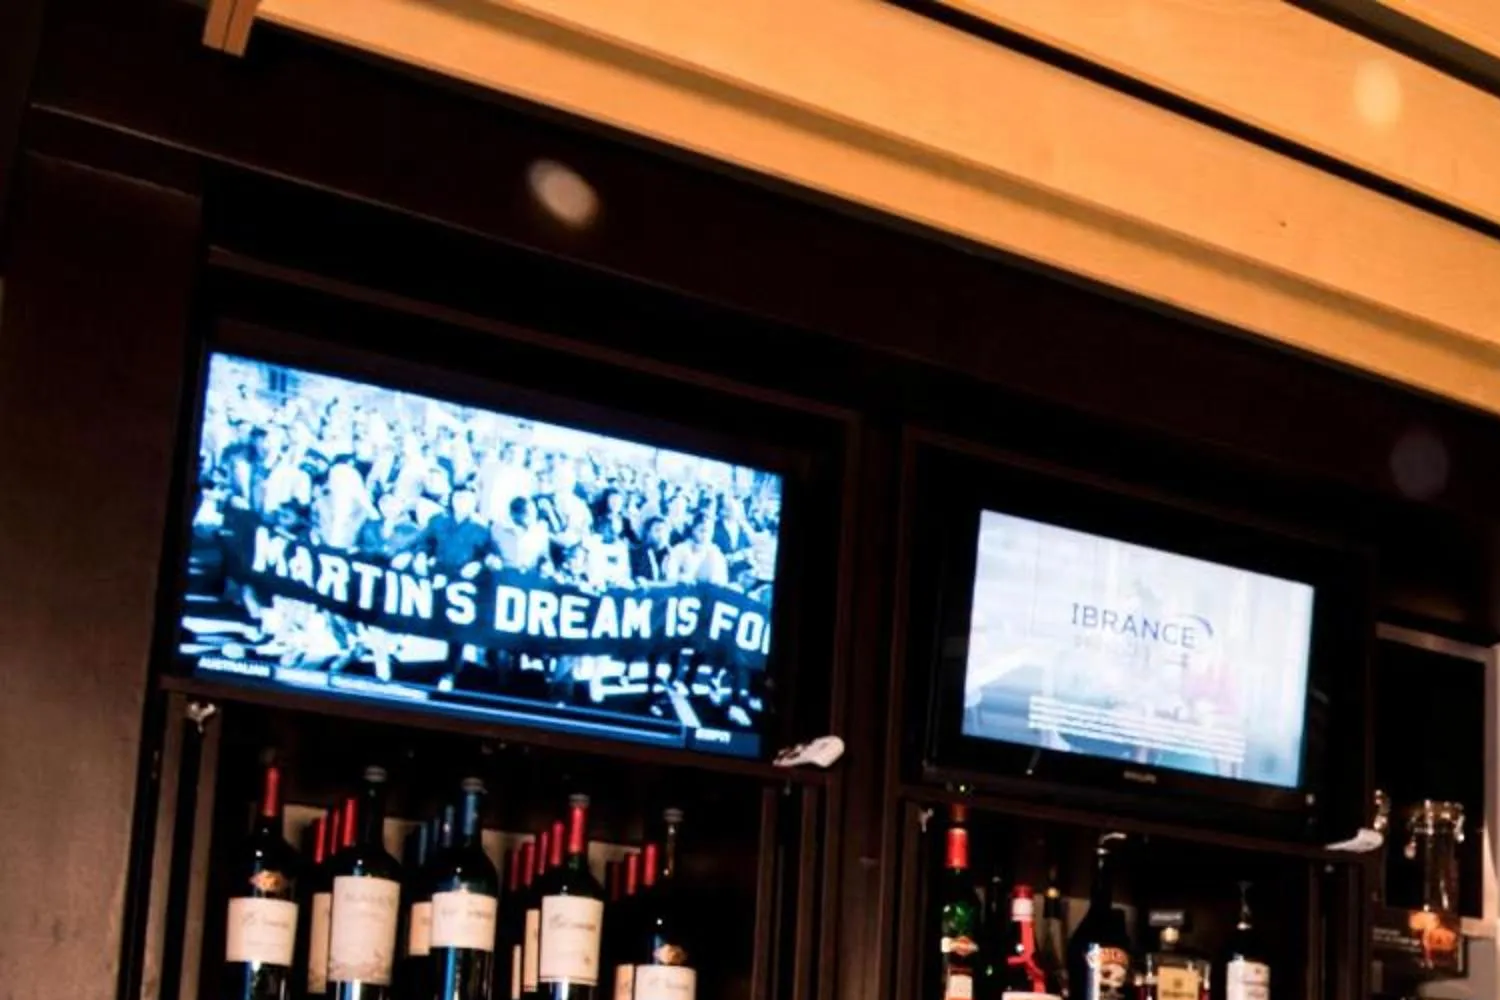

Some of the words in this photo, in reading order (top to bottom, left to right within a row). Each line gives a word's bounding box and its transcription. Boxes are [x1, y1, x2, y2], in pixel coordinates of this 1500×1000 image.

[252, 527, 477, 626] MARTIN'S
[494, 586, 652, 640] DREAM
[664, 597, 699, 638] IS
[1070, 602, 1197, 649] IBRANCE
